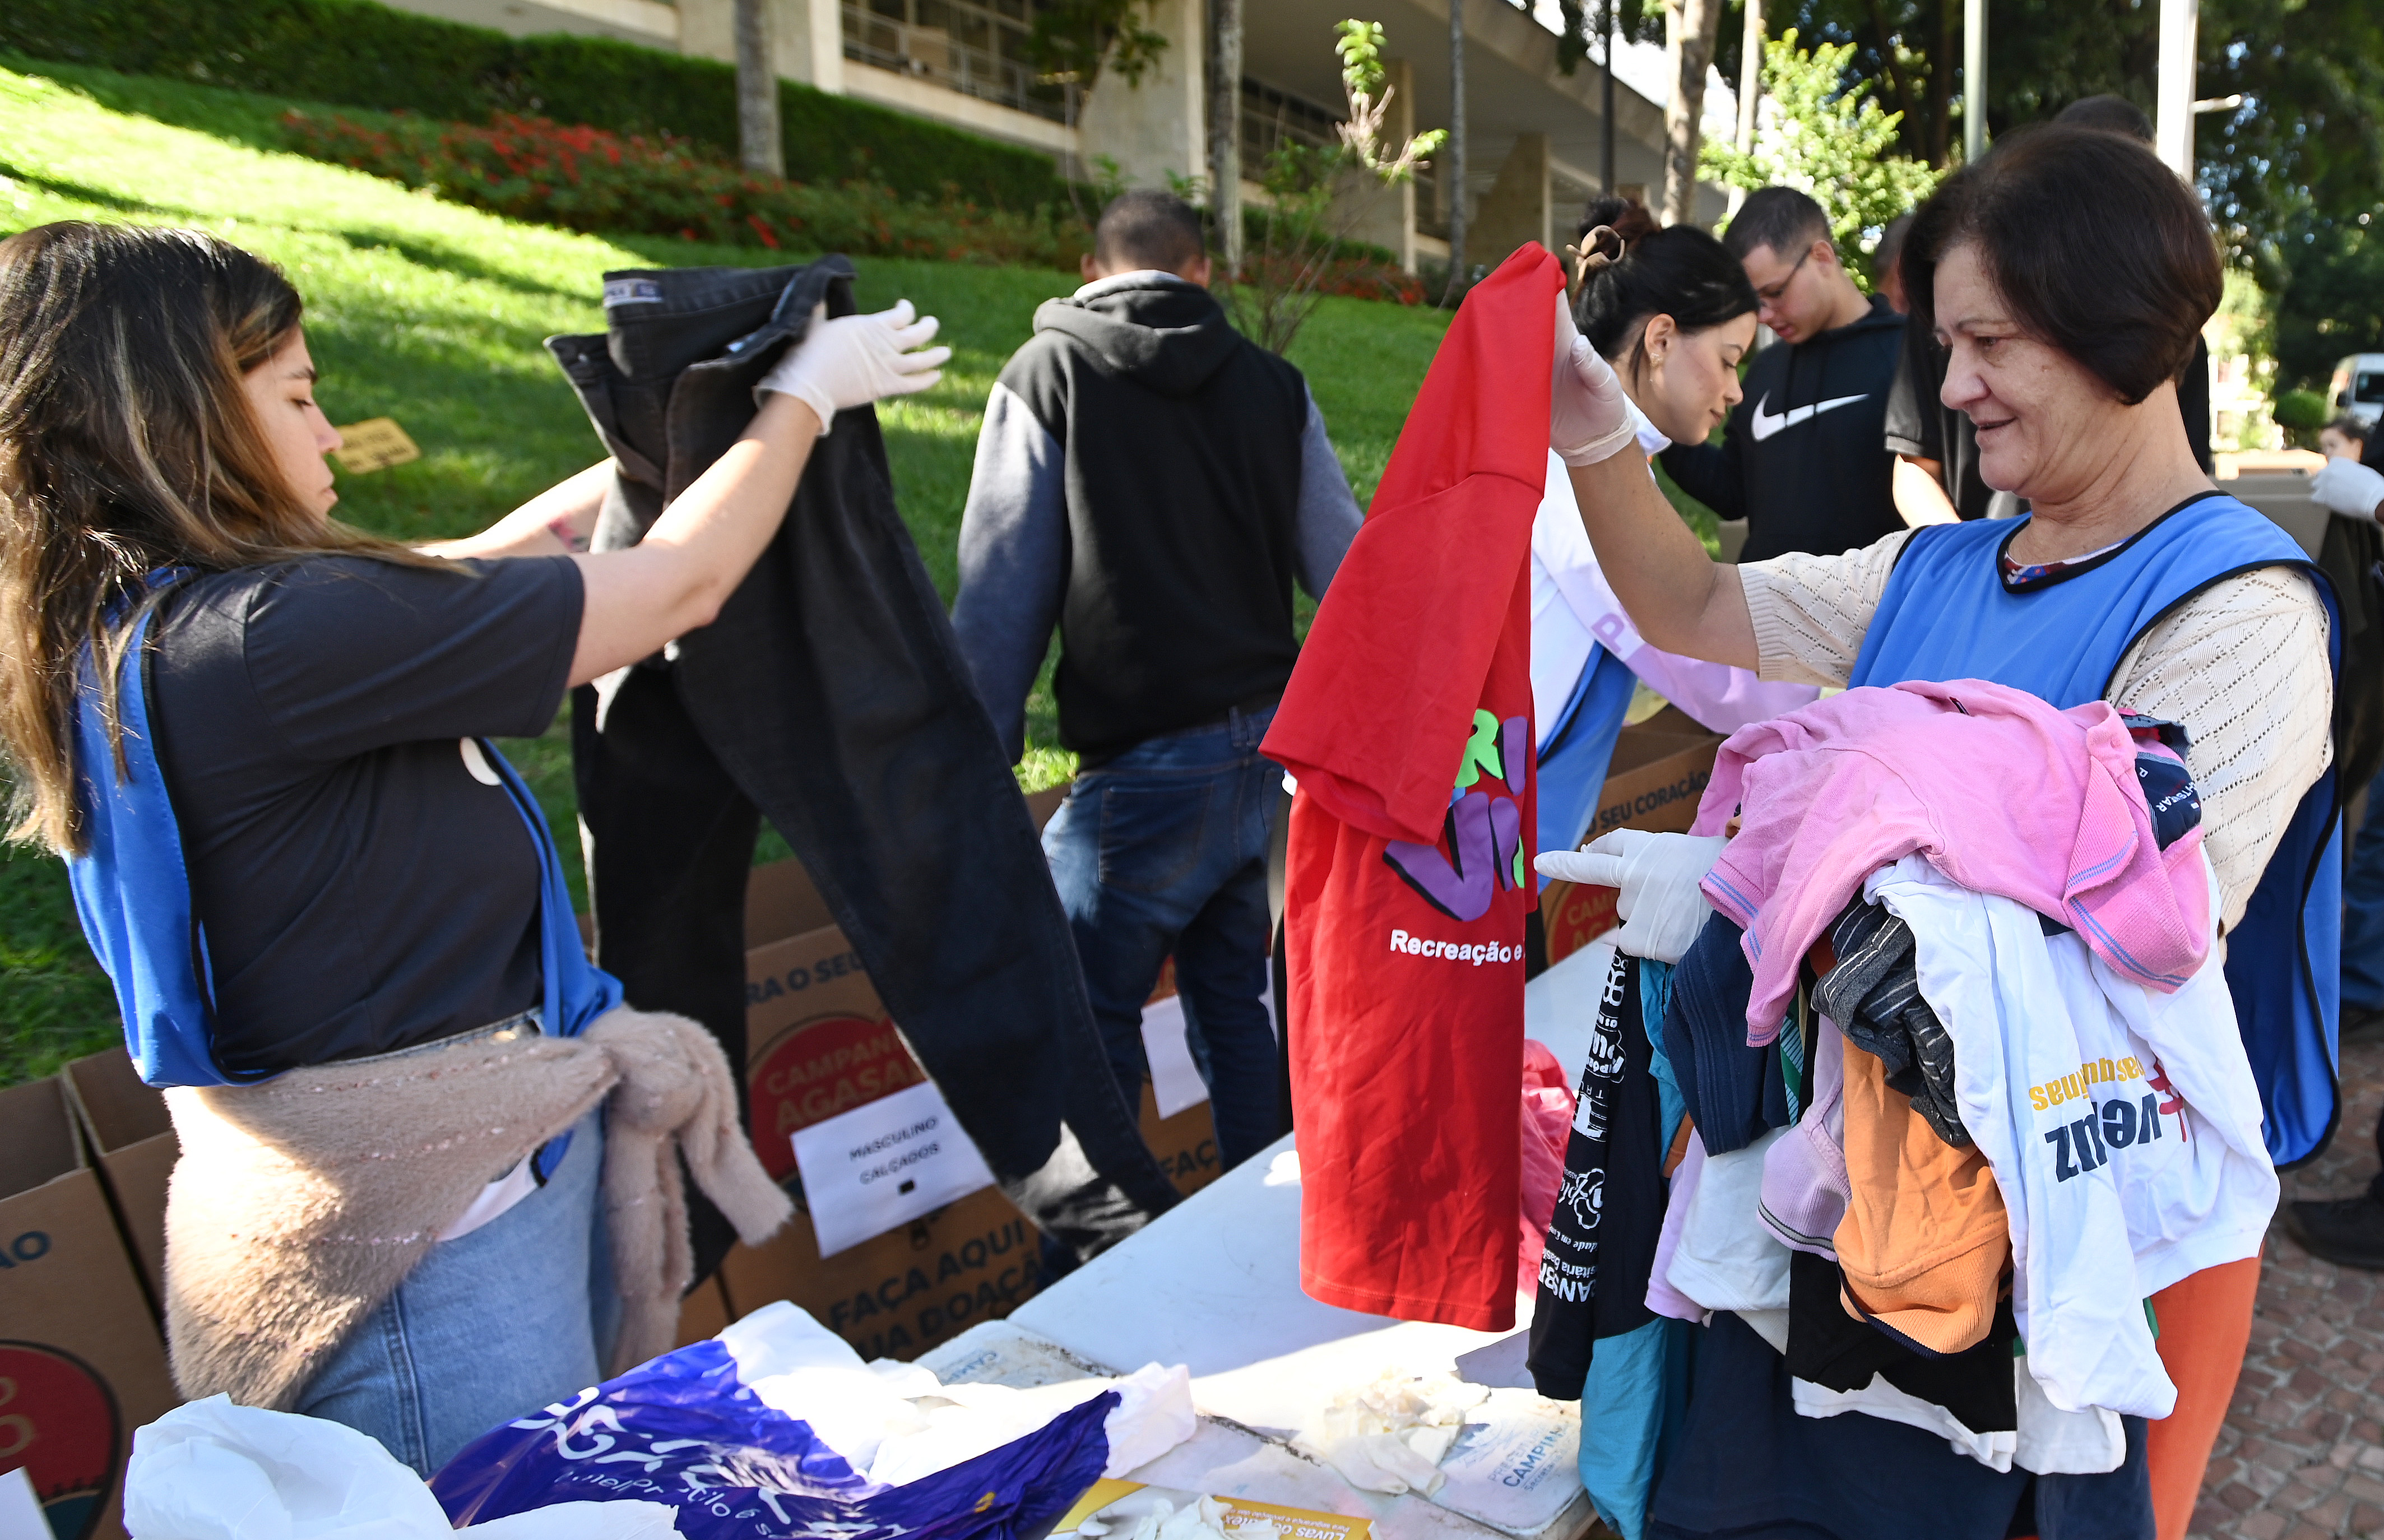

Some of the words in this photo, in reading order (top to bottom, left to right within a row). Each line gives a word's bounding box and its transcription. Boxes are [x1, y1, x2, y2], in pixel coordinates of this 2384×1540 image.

[1600, 803, 1633, 829] SEU
[1635, 771, 1710, 814] CORAÇÃO
[1390, 929, 1511, 966] Recreação
[1514, 944, 1522, 961] e
[849, 1116, 938, 1161] MASCULINO
[939, 1218, 1025, 1284] AQUI
